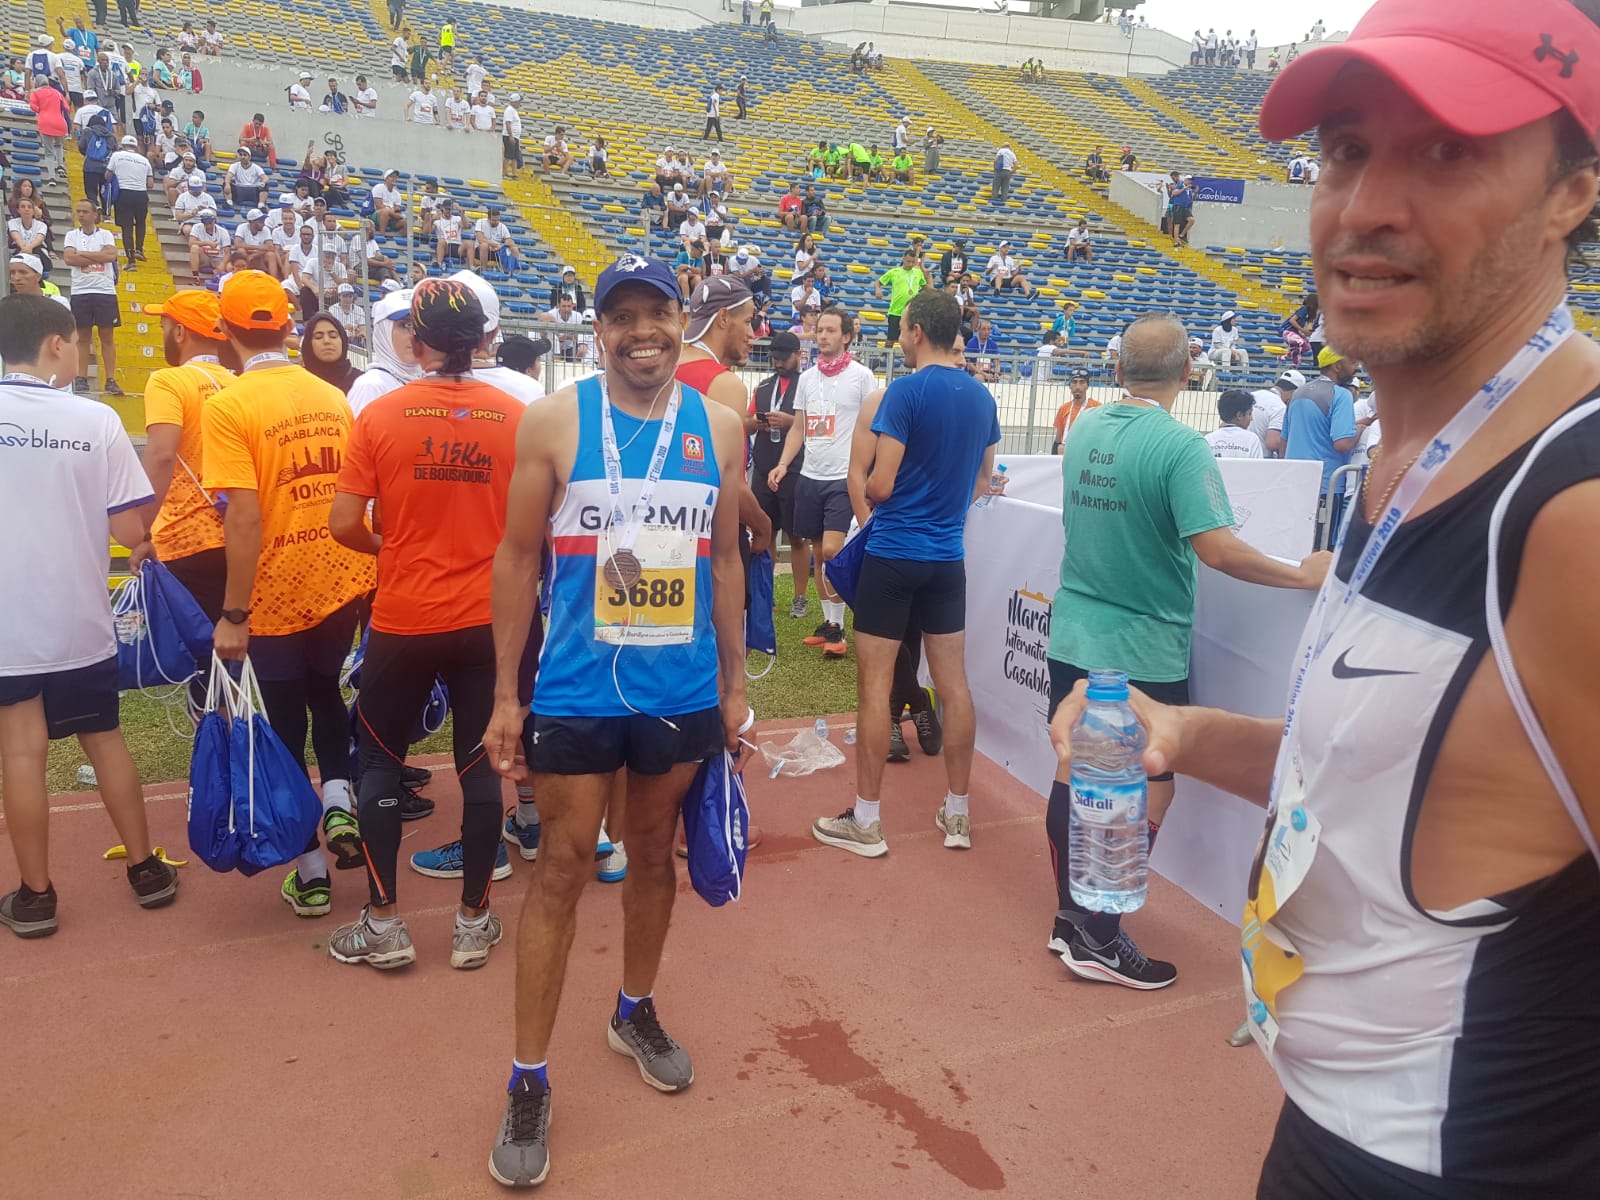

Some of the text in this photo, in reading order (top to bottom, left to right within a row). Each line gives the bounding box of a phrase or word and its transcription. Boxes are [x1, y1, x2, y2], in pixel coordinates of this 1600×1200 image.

[404, 407, 506, 423] PLANET SPORT
[414, 467, 430, 480] DE
[1377, 507, 1402, 540] 2019
[273, 526, 329, 549] MAROC
[1074, 790, 1113, 810] Sidi ali
